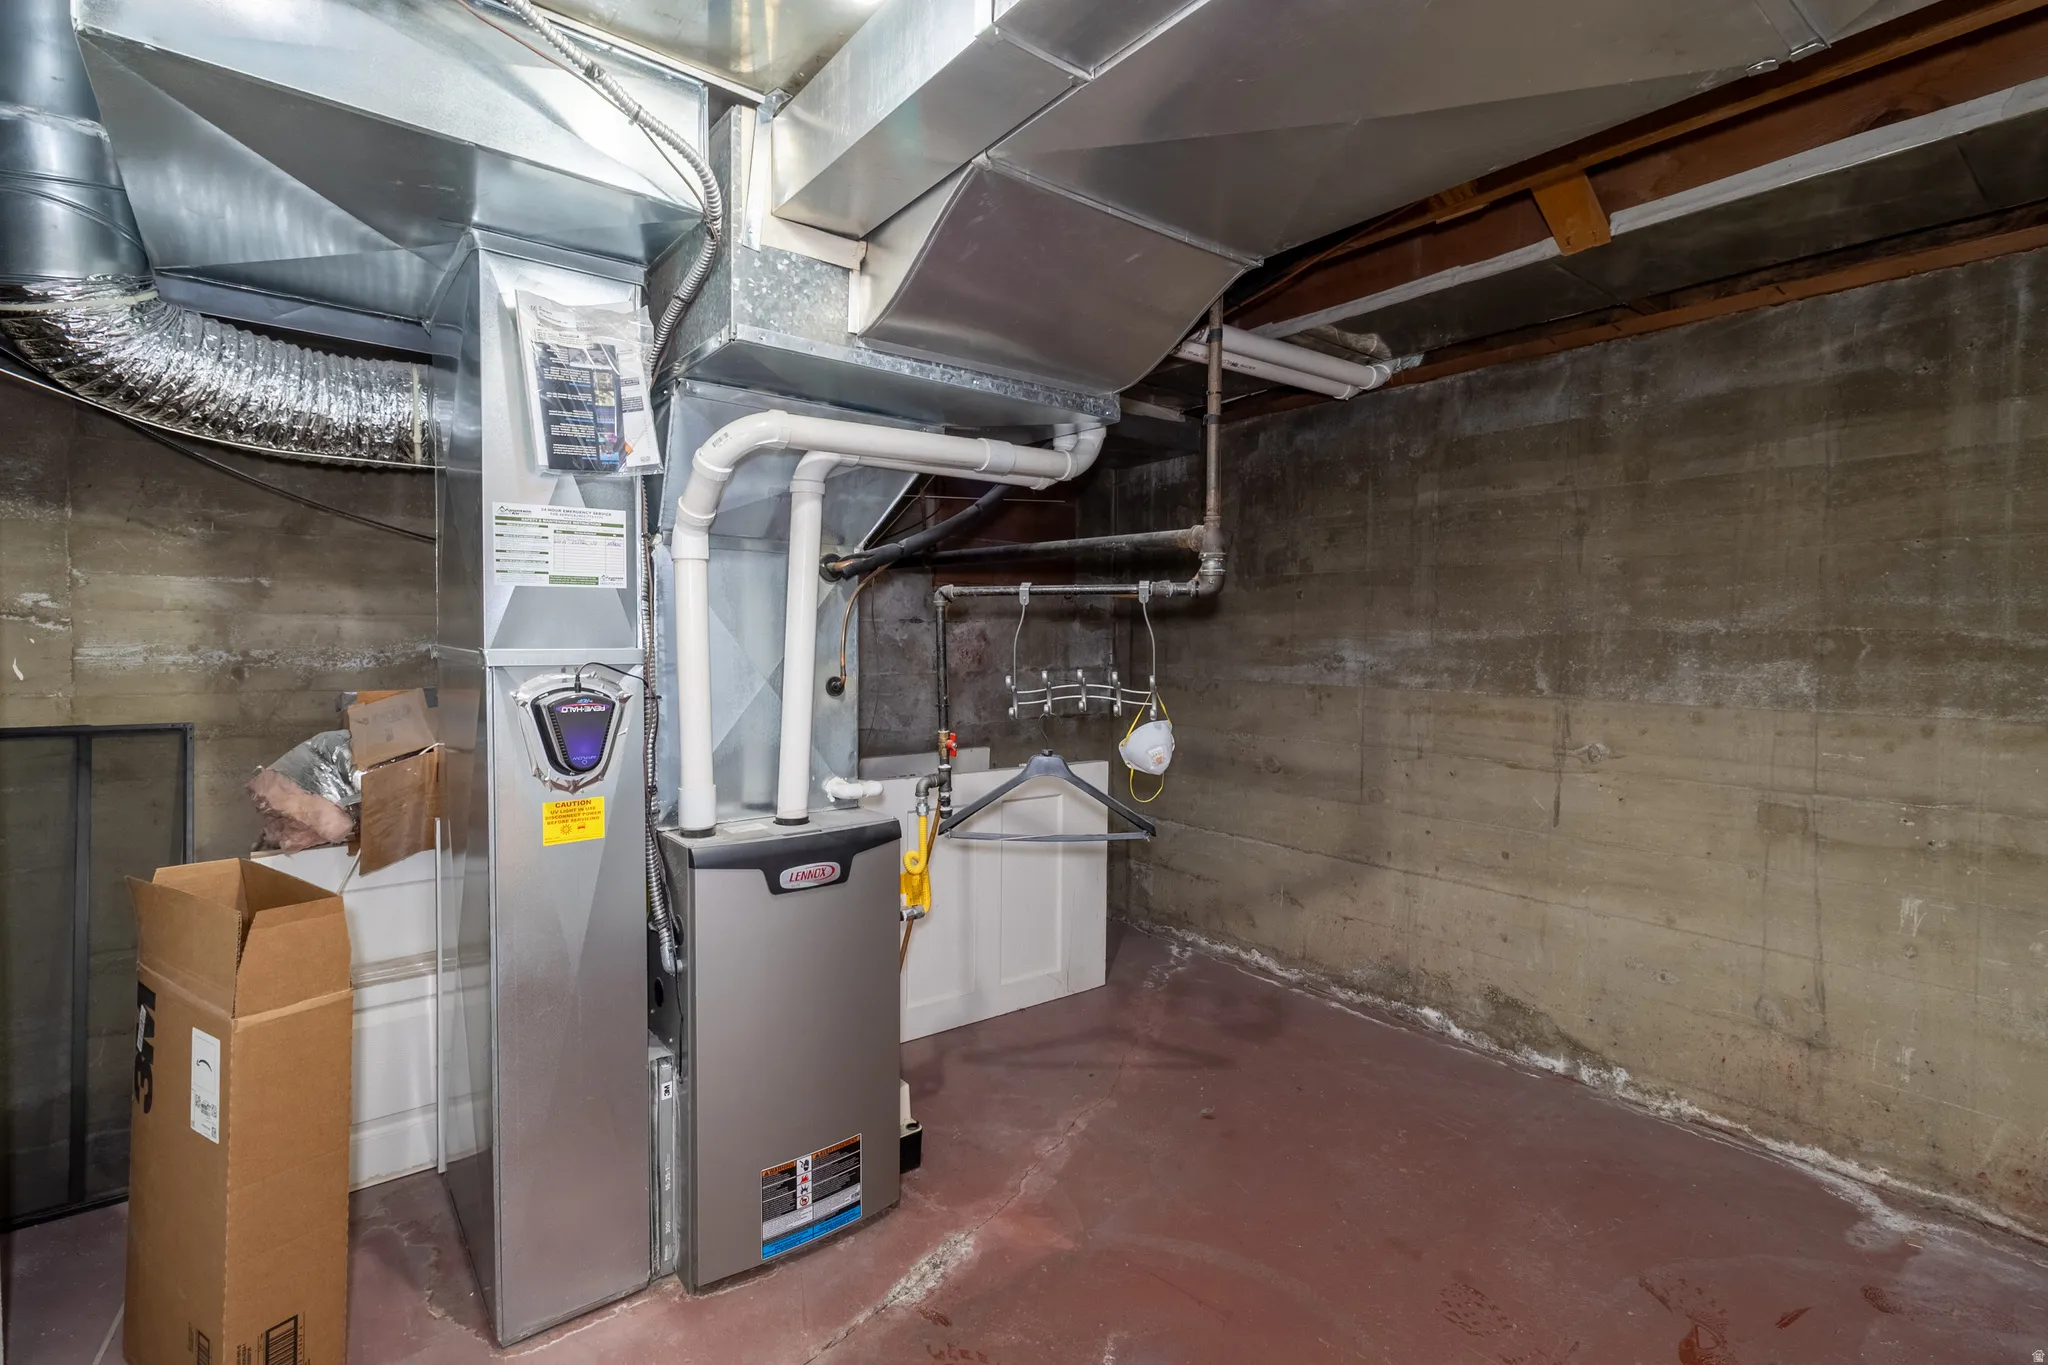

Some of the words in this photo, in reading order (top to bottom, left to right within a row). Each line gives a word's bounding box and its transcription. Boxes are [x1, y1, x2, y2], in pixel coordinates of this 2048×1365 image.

[555, 799, 592, 809] CAUTION
[545, 813, 581, 821] DISCONNECT
[570, 815, 600, 823] SERVICING
[789, 867, 827, 882] LENNOX
[134, 981, 156, 1114] 3M
[664, 1084, 671, 1097] 3M
